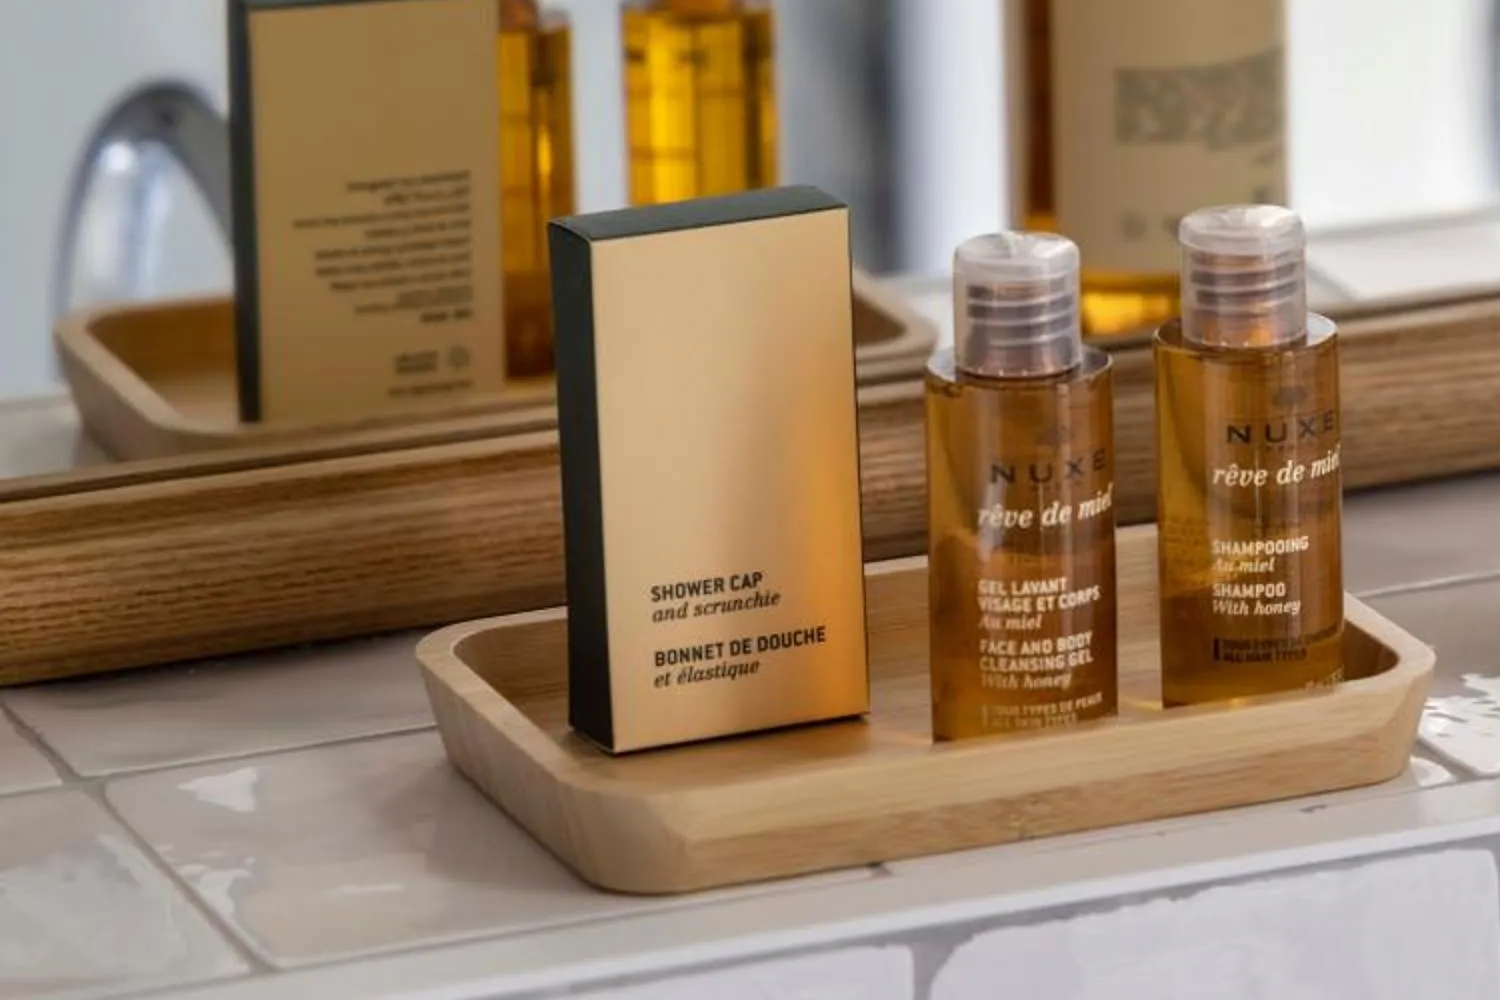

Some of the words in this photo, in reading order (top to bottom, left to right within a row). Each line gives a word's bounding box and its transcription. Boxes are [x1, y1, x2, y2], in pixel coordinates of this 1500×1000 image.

[1227, 409, 1335, 444] NUXE
[991, 447, 1108, 484] NUXE
[1212, 462, 1269, 488] rêve
[1275, 459, 1306, 486] de
[978, 503, 1034, 529] rêve
[1041, 499, 1072, 527] de
[1077, 482, 1114, 521] miel
[1212, 535, 1309, 556] SHAMPOOING
[650, 577, 725, 602] SHOWER
[730, 571, 763, 591] CAP
[1011, 576, 1068, 596] LAVANT
[1036, 595, 1056, 612] ET
[1058, 584, 1101, 610] CORPS
[1212, 581, 1286, 598] SHAMPOO
[652, 602, 688, 624] and
[693, 591, 781, 617] scrunchie
[1253, 600, 1302, 616] honey
[654, 641, 725, 667] BONNET
[730, 638, 753, 657] DE
[757, 625, 826, 652] DOUCHE
[1020, 637, 1053, 655] AND
[1056, 630, 1093, 652] BODY
[653, 671, 671, 688] et
[676, 658, 761, 686] élastique
[979, 654, 1066, 673] CLEANSING
[1068, 647, 1094, 668] GEL
